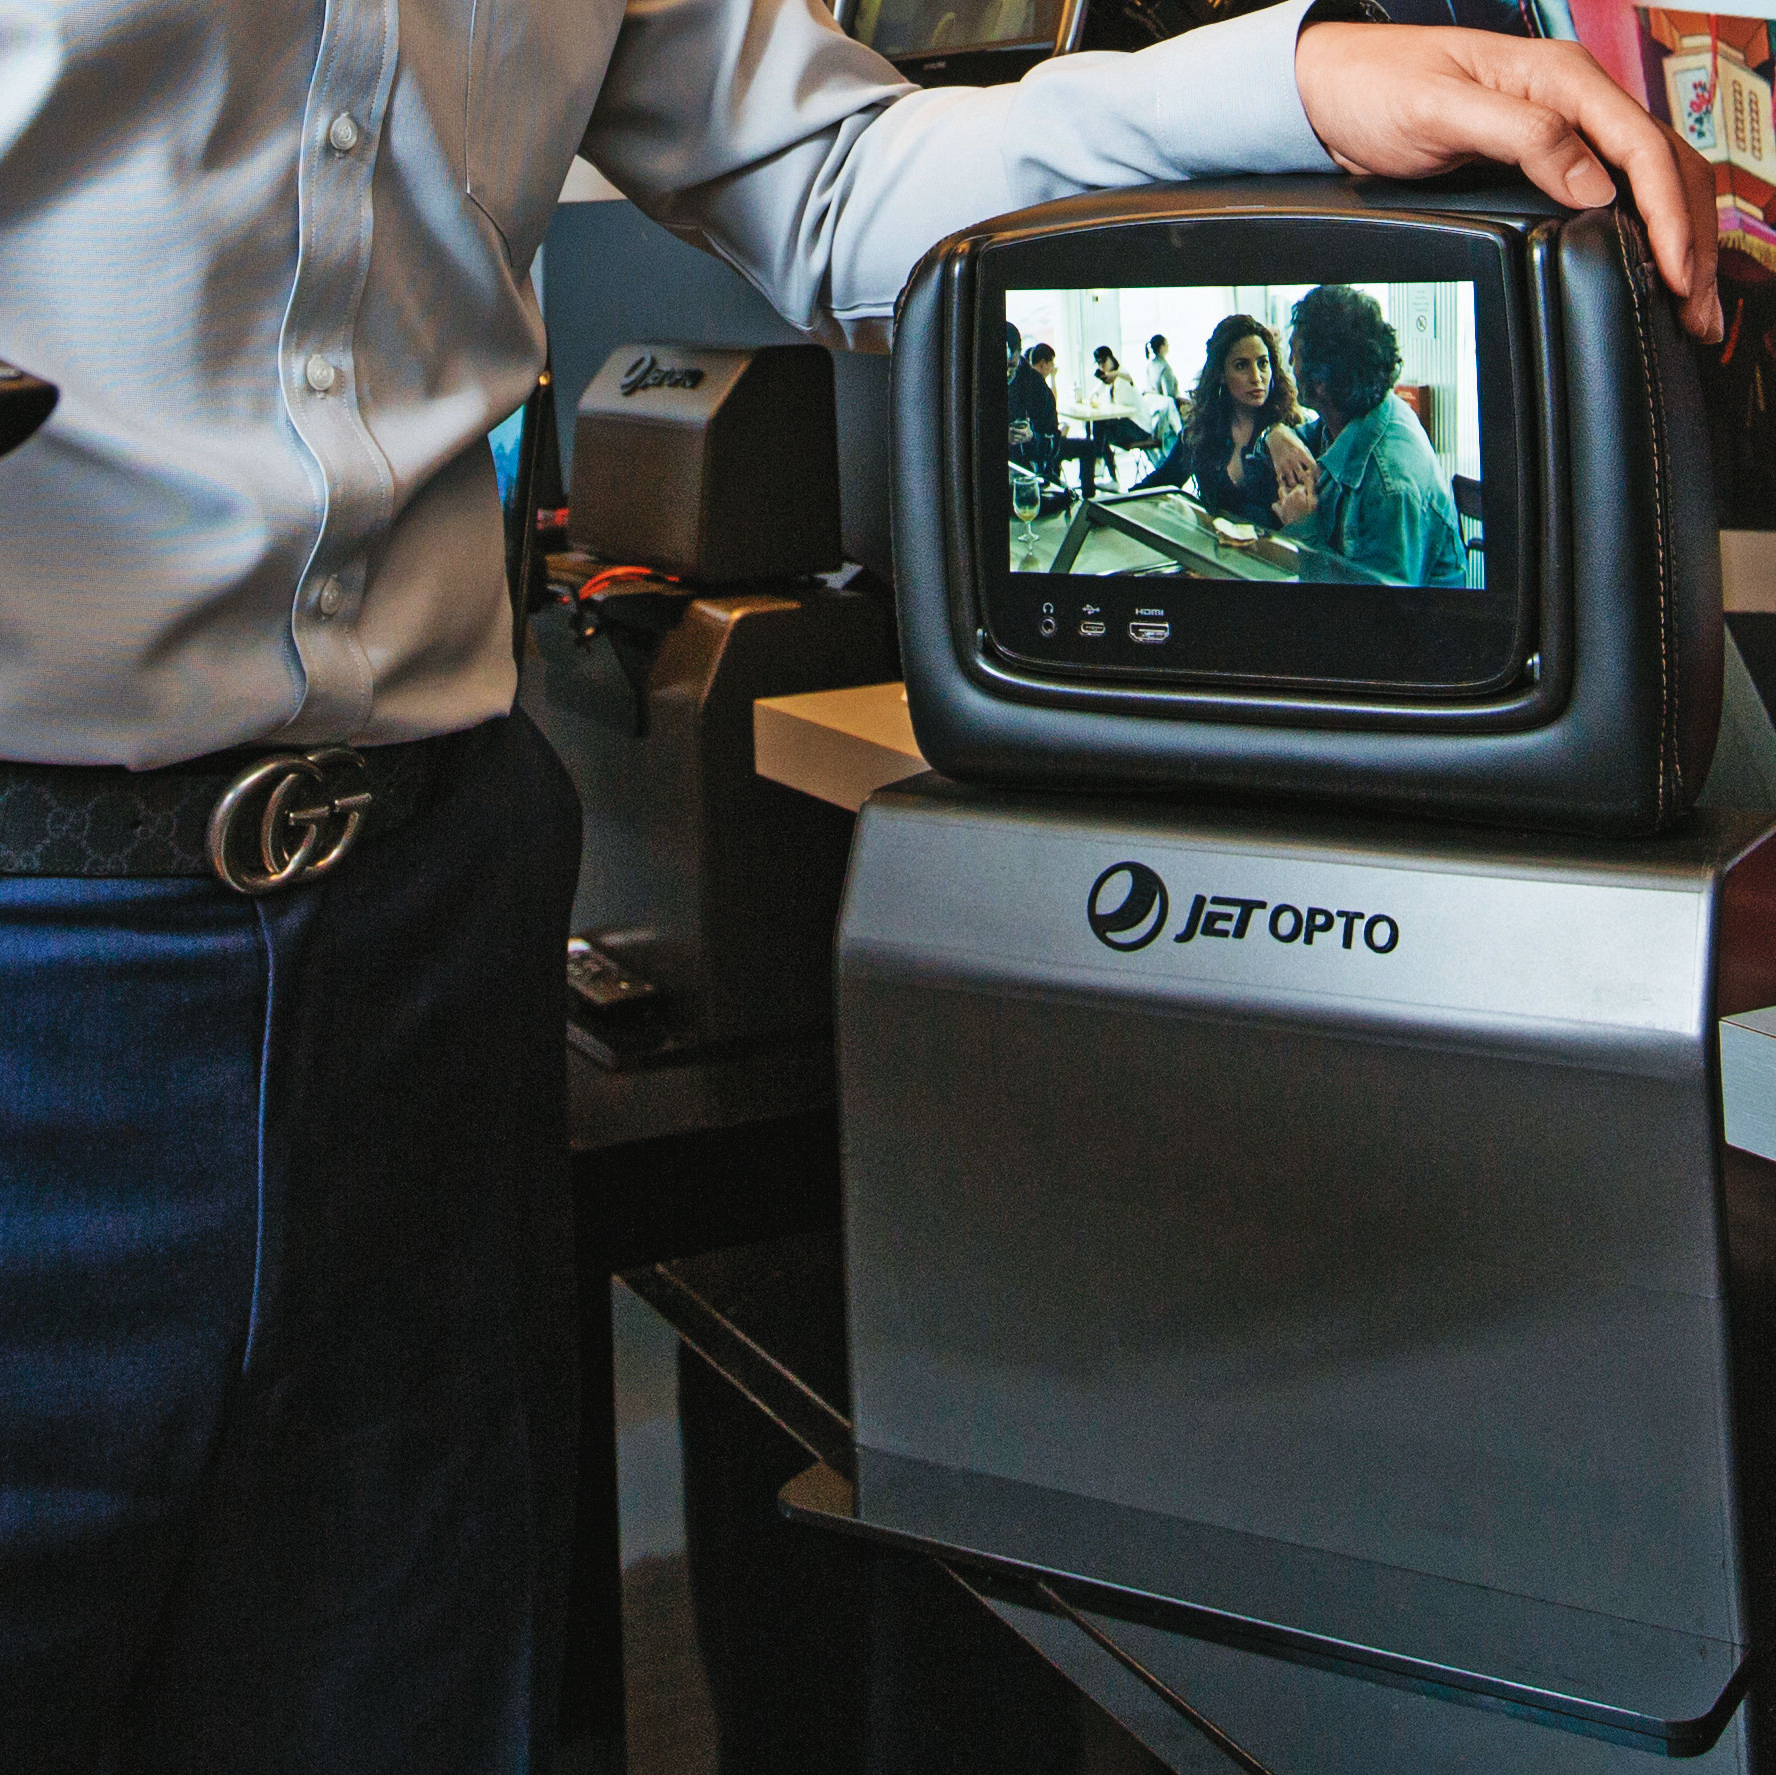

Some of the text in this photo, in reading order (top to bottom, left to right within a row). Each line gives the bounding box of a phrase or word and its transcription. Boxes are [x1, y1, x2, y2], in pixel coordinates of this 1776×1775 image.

[1135, 608, 1165, 617] HDMI
[1172, 893, 1401, 955] JET OPTO
